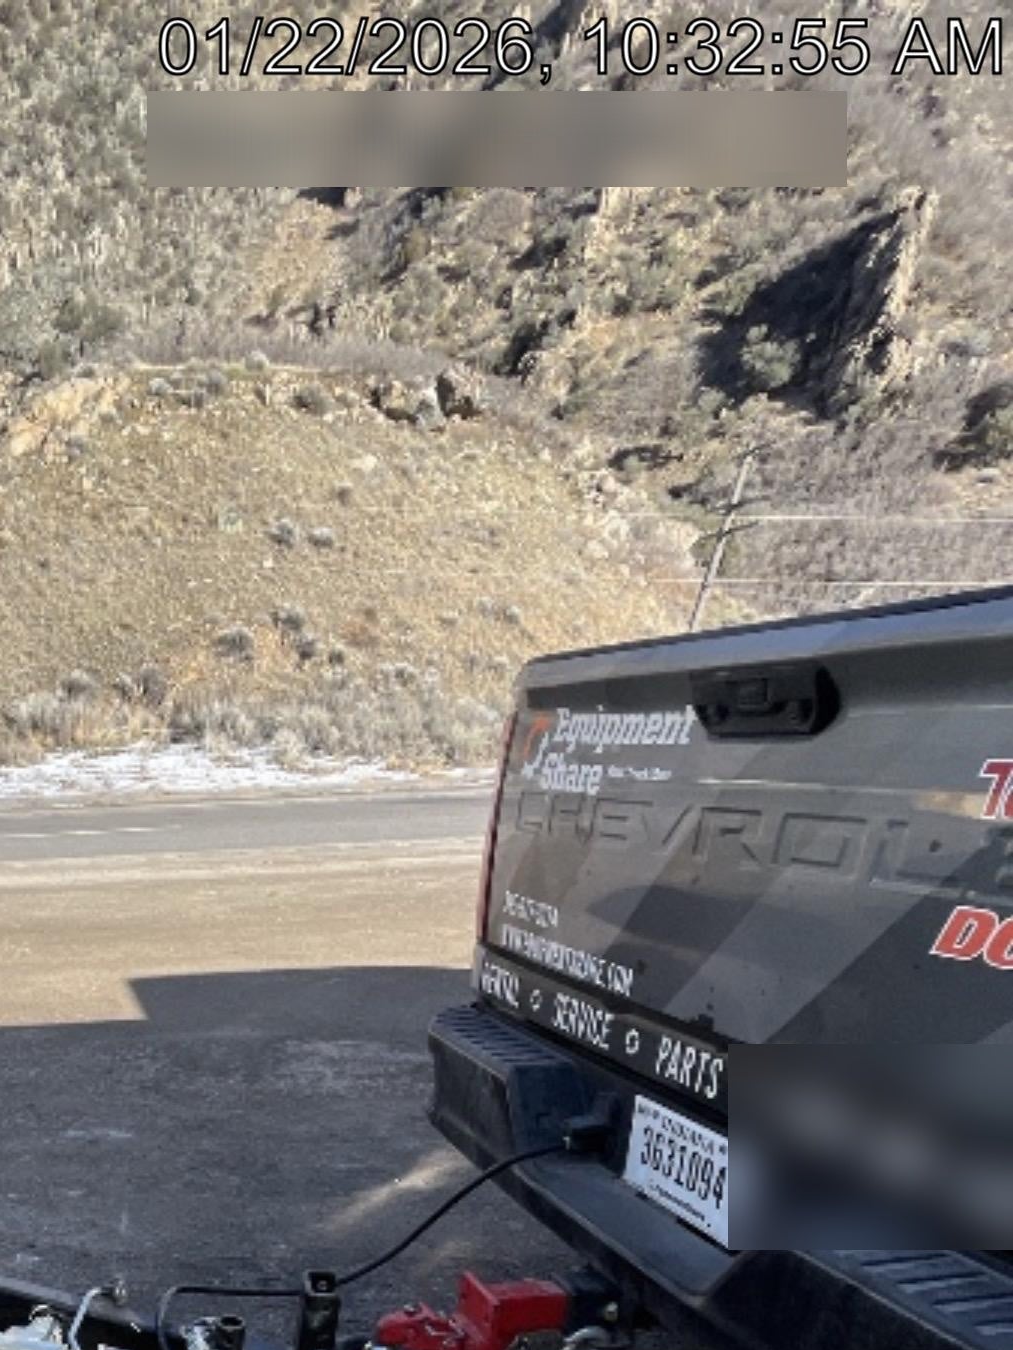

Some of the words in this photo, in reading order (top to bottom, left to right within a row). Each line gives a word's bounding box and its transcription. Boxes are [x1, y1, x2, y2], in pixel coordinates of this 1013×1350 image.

[552, 703, 698, 754] Equipment
[540, 752, 604, 796] Share
[552, 992, 615, 1050] SERVICE
[655, 1034, 725, 1099] PARTS
[639, 1124, 727, 1210] 3631094
